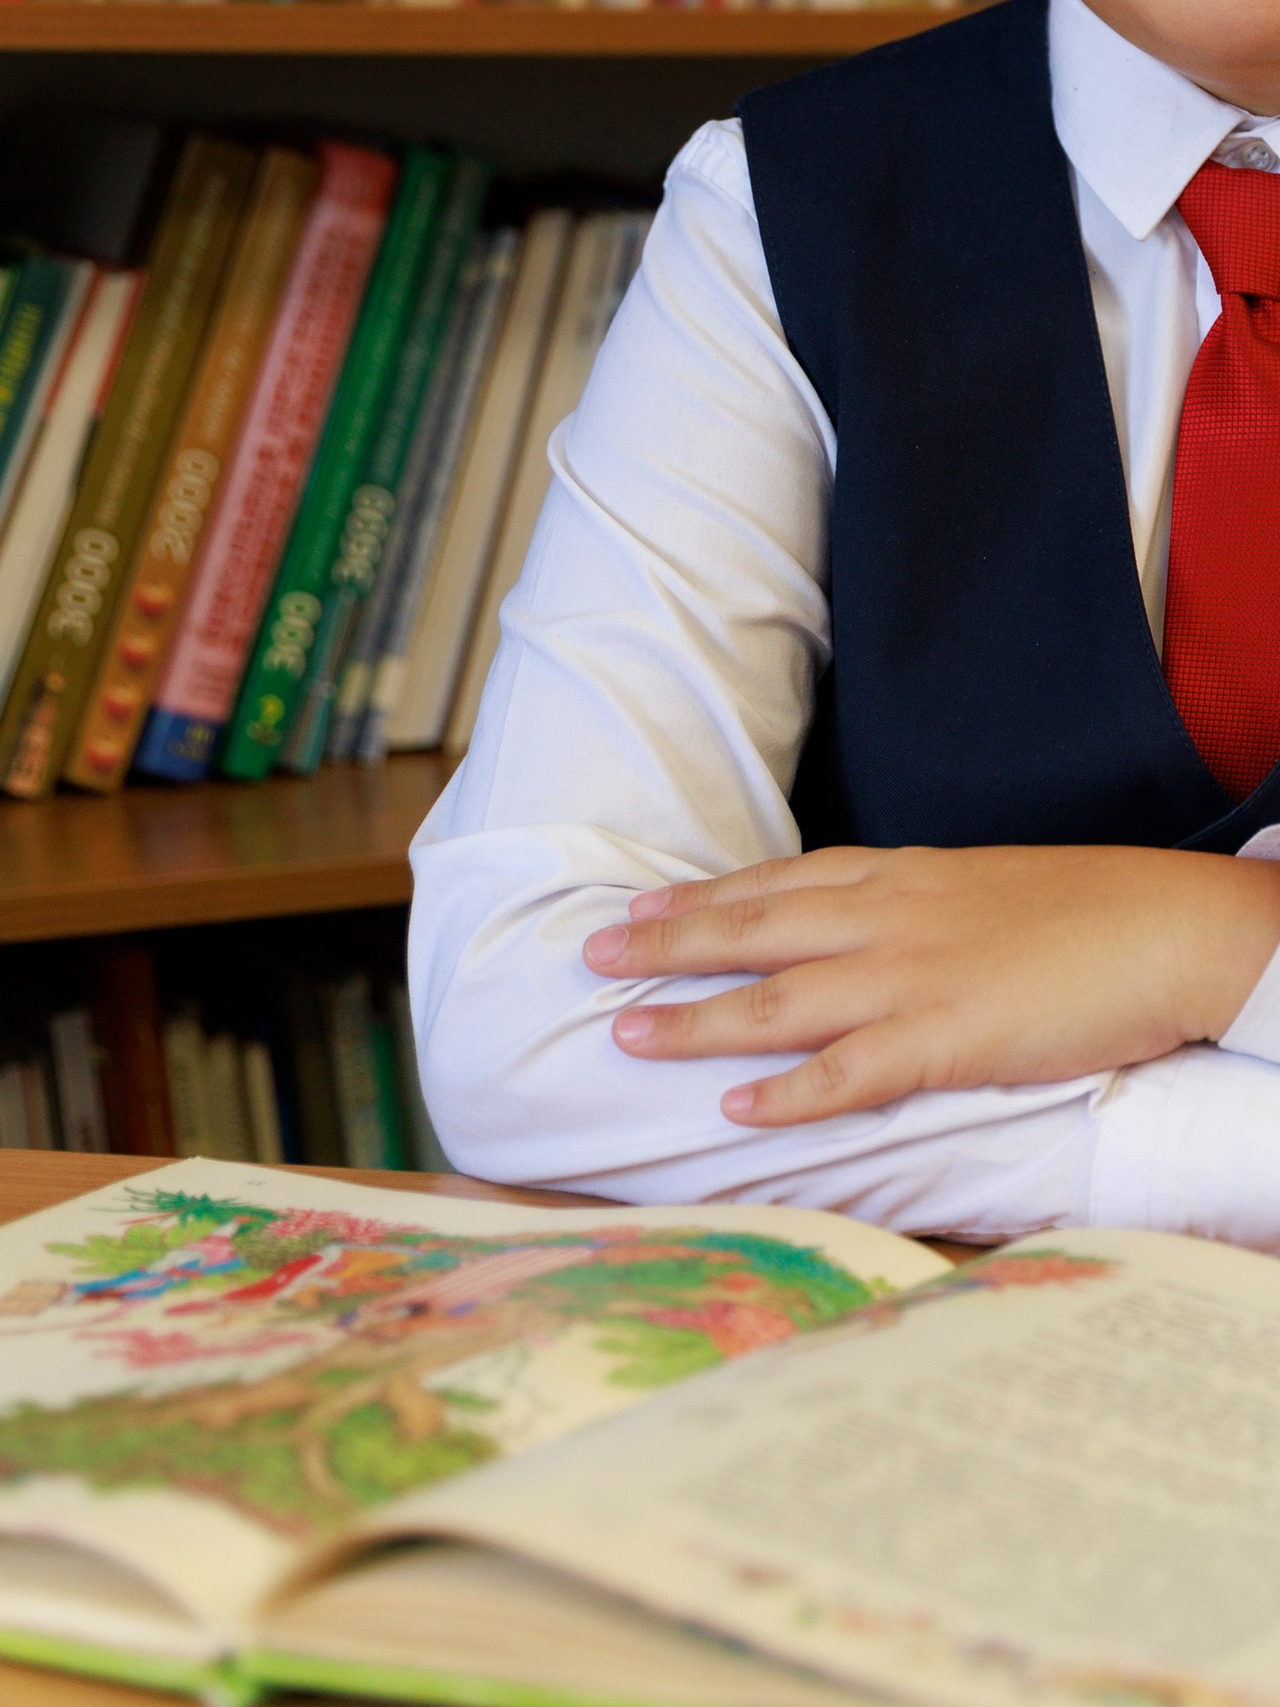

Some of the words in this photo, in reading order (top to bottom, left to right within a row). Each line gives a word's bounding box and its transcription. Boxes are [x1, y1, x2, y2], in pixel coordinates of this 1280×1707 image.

[149, 447, 221, 567] 2000
[48, 527, 120, 648] 3000
[264, 591, 323, 680] 300
